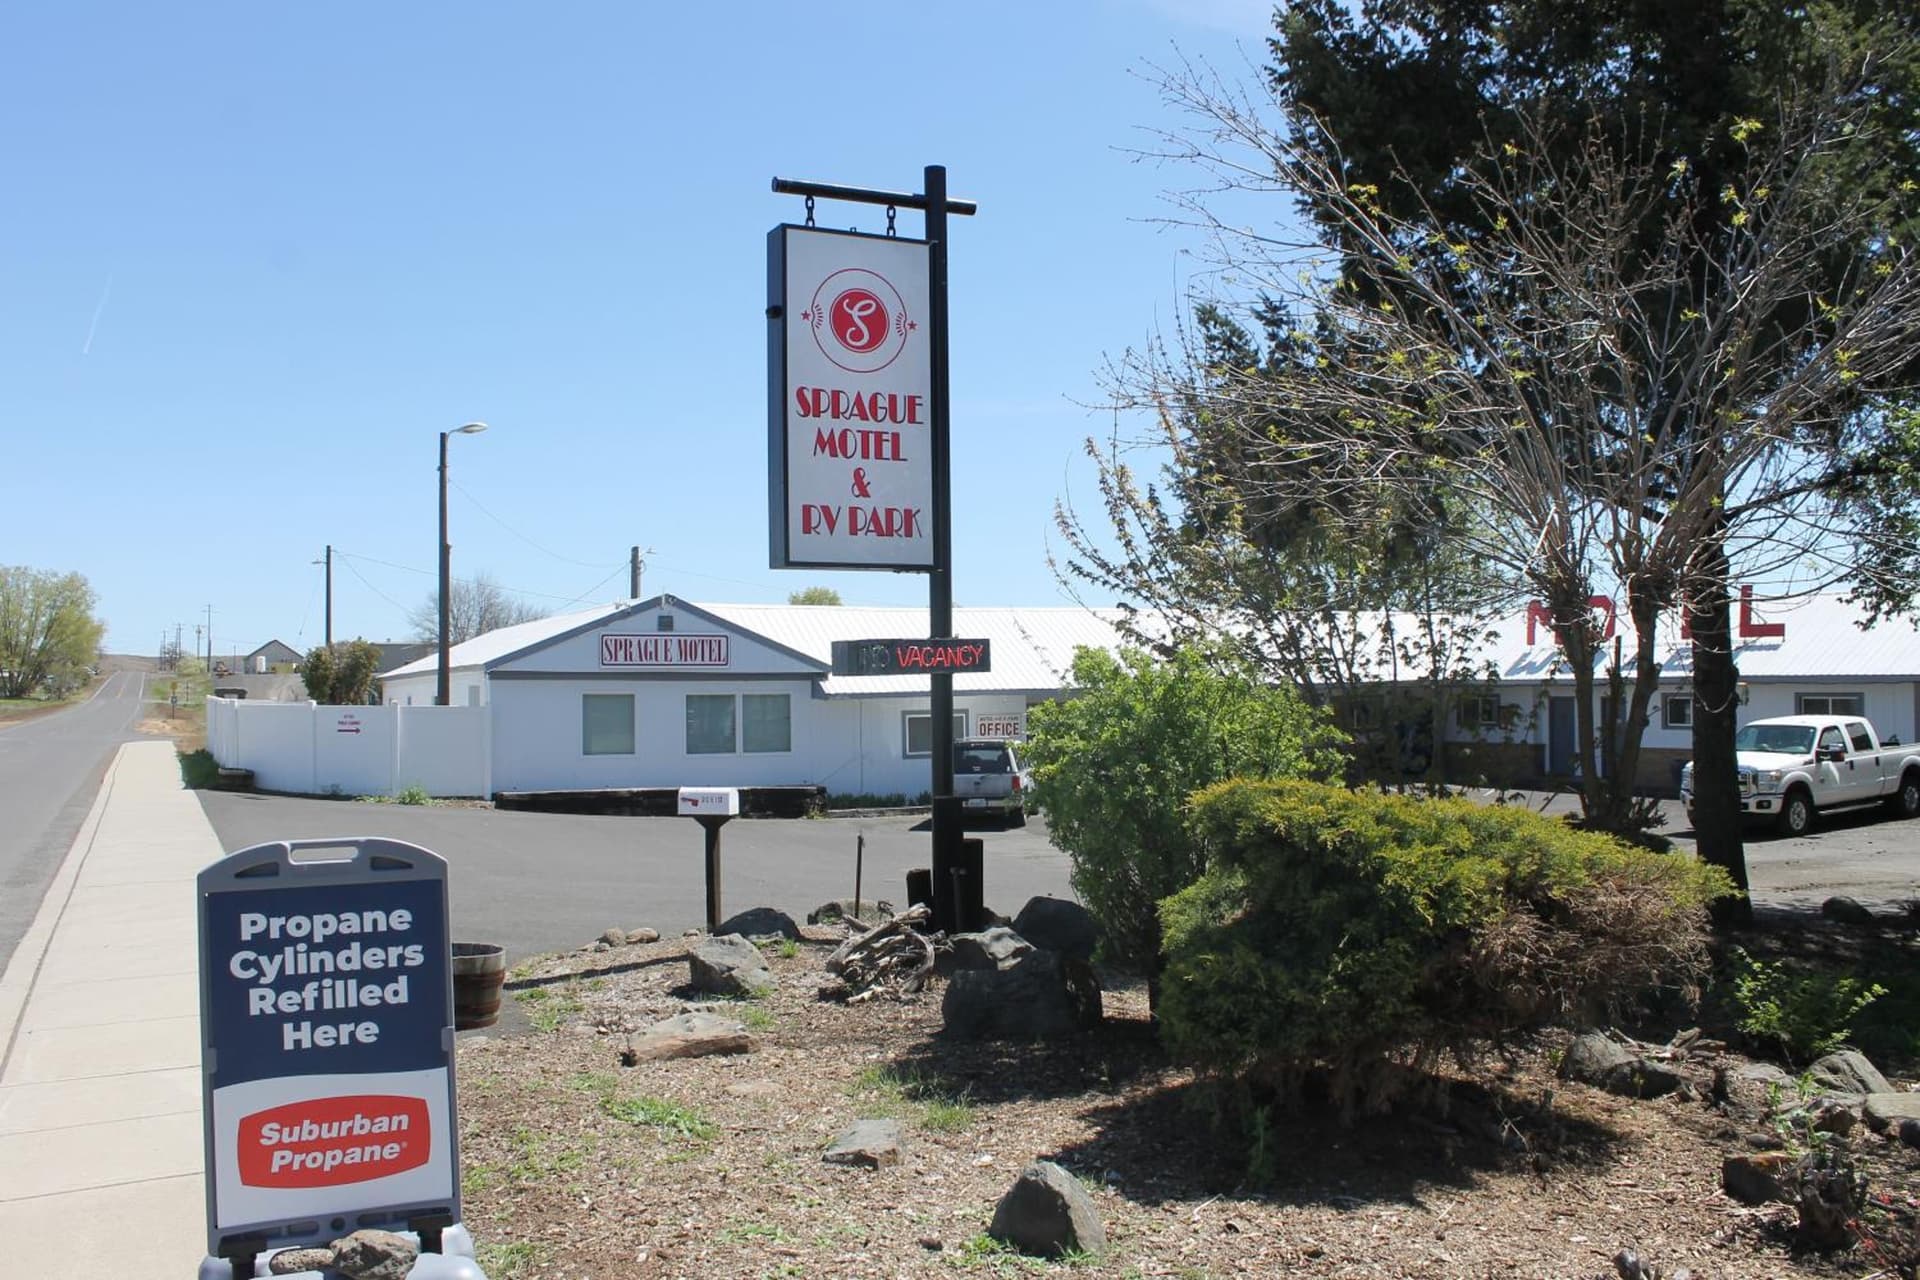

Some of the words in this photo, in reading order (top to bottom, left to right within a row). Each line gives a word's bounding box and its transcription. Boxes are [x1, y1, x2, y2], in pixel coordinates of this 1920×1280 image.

[796, 386, 923, 424] SPRAGUE
[813, 427, 908, 462] MOTEL
[851, 467, 871, 498] &
[802, 504, 841, 536] RV
[848, 506, 922, 538] PARK
[604, 638, 673, 662] SPRAGUE
[677, 638, 727, 662] MOTEL
[896, 644, 984, 668] VACANCY
[980, 722, 1019, 736] OFFICE
[240, 908, 413, 943] Propane
[229, 942, 425, 984] Cylinders
[248, 975, 410, 1016] Refilled
[282, 1020, 380, 1051] Here
[259, 1111, 409, 1146] Suburban
[270, 1142, 402, 1174] Propane
